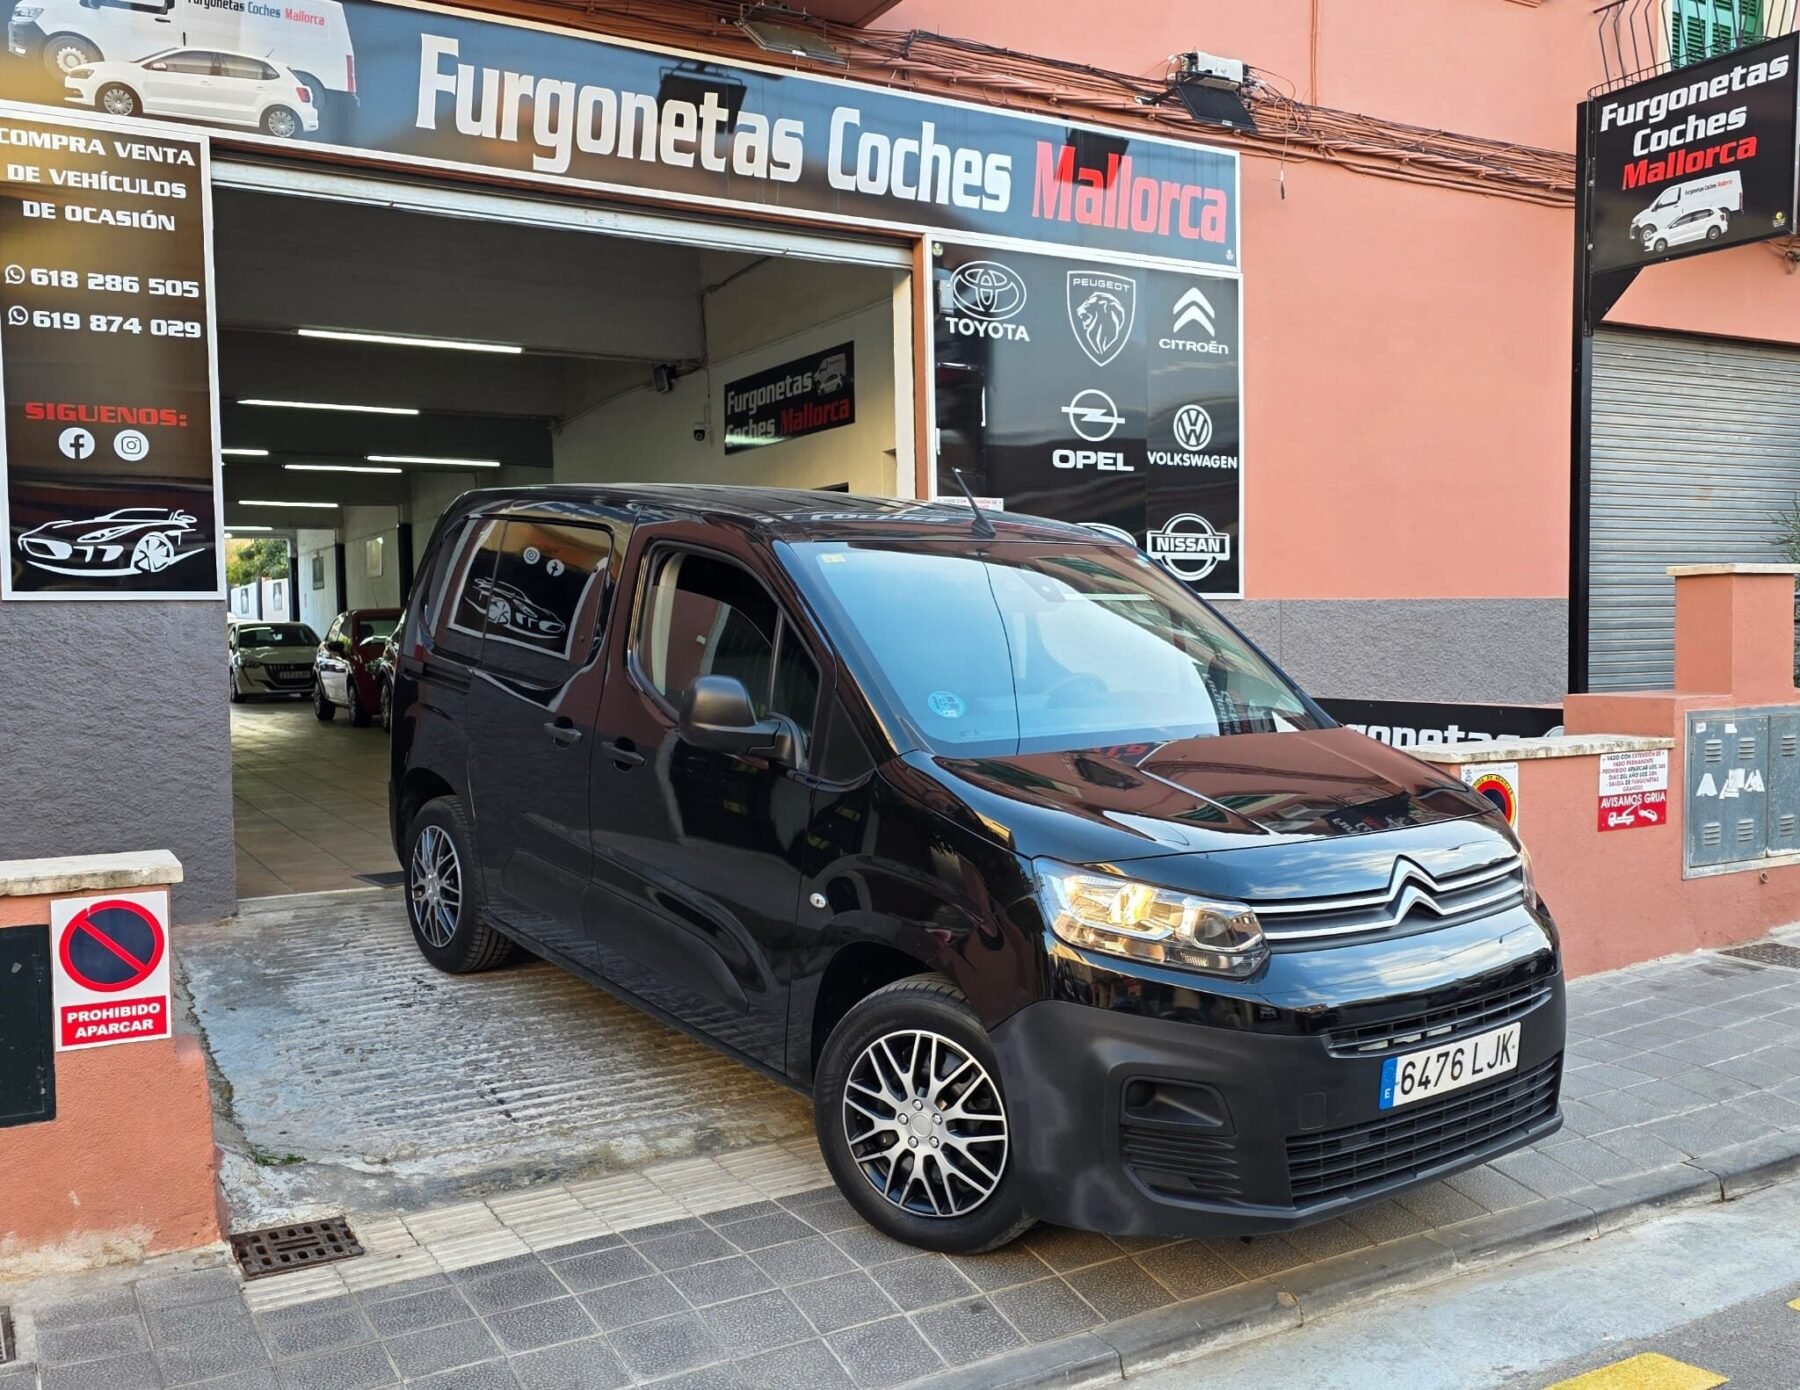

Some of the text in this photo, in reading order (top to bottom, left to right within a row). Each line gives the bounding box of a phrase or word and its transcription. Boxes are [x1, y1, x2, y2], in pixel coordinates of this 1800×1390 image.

[248, 2, 281, 18] Coches
[284, 8, 325, 26] Mallorca
[1600, 54, 1790, 132] Furgonetas
[415, 33, 1227, 244] Furgonetas Coches Mallorca
[1633, 106, 1748, 157] Coches
[0, 127, 196, 166] COMPRA VENTA
[1622, 136, 1758, 190] Mallorca
[7, 164, 187, 199] DE VEHÍCULOS
[23, 201, 176, 231] DE OCASIÓN
[30, 268, 200, 298] 618 286 505
[1072, 277, 1130, 293] PEUGEOT
[32, 310, 201, 338] 619 874 029
[945, 316, 1030, 342] TOYOTA
[727, 371, 813, 415] Furgonetas
[25, 401, 188, 427] SIGUENOS:
[780, 399, 850, 435] Mallorca
[1052, 449, 1135, 472] OPEL
[1147, 451, 1238, 469] VOLKSWAGEN
[1156, 536, 1220, 554] NISSAN
[1601, 792, 1666, 809] AVISAMOS GRUA
[67, 1002, 161, 1024] PROHIBIDO
[75, 1018, 154, 1038] APARCAR
[1384, 1030, 1514, 1099] E 6476 LJK
